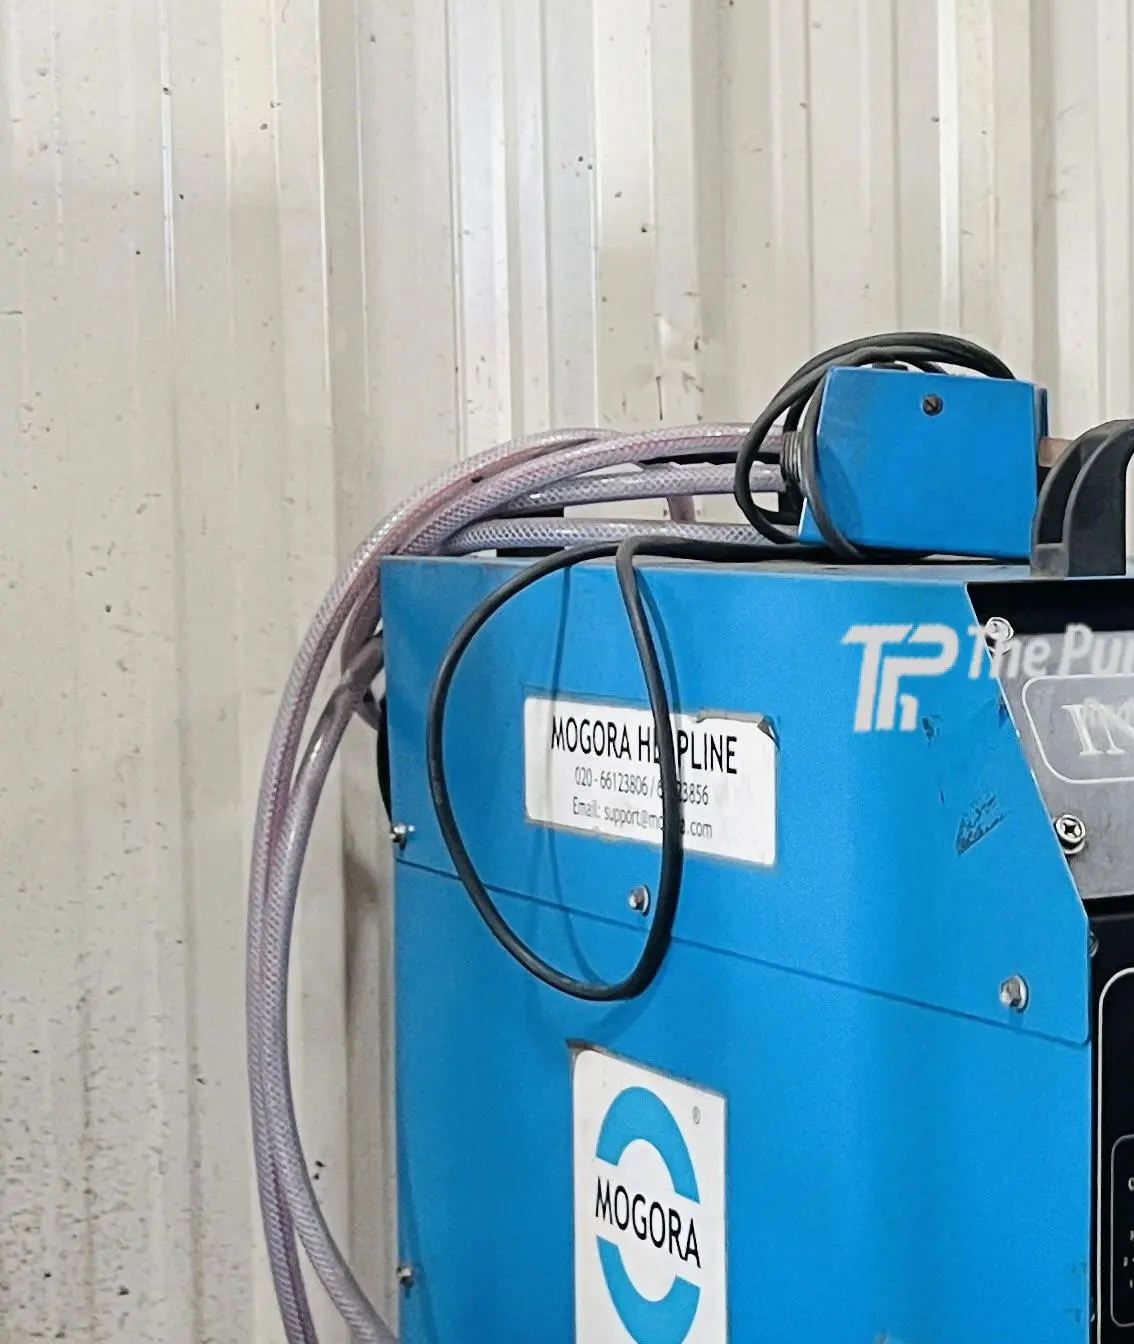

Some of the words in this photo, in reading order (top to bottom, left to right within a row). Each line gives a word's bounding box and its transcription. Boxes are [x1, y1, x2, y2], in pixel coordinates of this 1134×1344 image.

[551, 715, 632, 761] MOGORA
[574, 766, 592, 788] 020
[600, 768, 648, 798] 66123806
[595, 1175, 702, 1268] MOGORA
